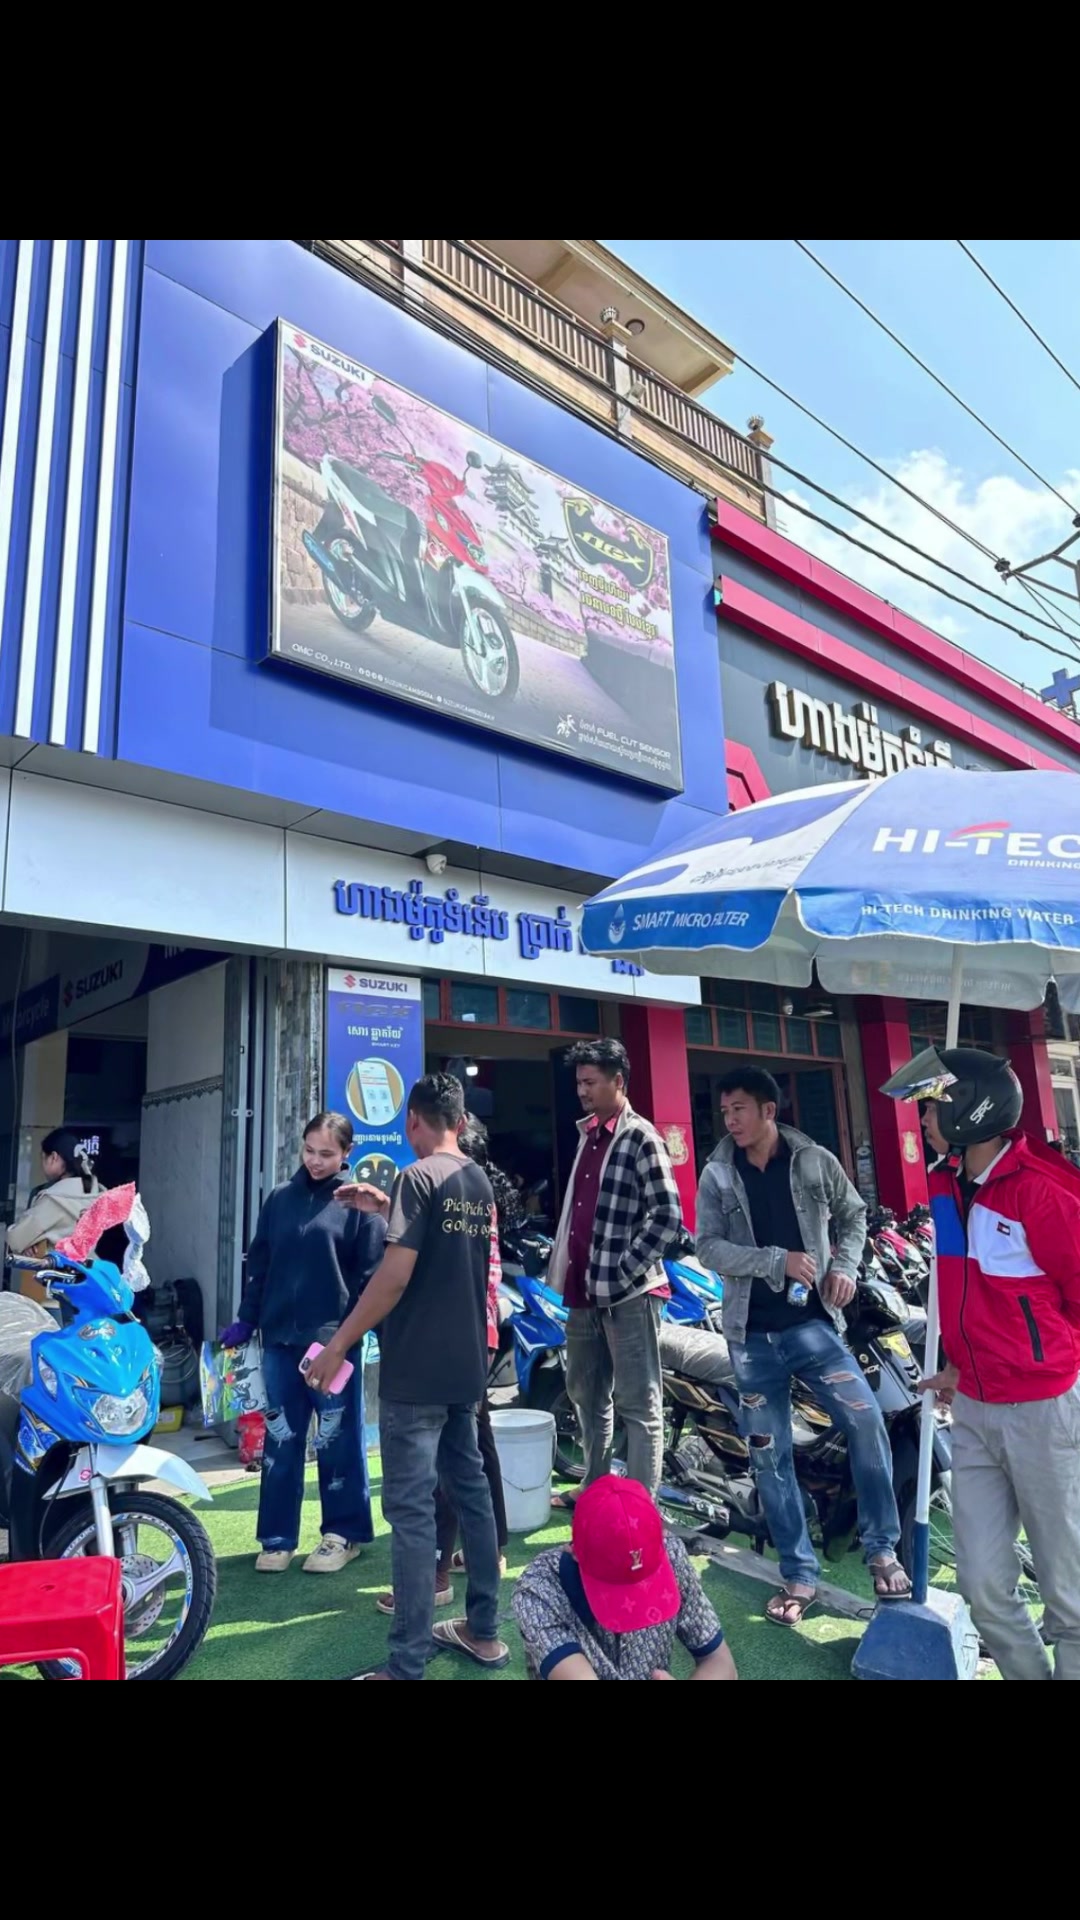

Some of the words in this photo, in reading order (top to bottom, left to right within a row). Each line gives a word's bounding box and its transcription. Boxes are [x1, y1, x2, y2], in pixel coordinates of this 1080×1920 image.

[310, 344, 365, 381] SUZUKI
[597, 727, 619, 742] FUEL
[620, 735, 638, 748] CUT
[639, 742, 671, 759] SENSOR
[632, 910, 675, 931] SMART
[861, 903, 924, 916] HI-TECH
[930, 907, 1012, 920] DRINKING
[1017, 908, 1075, 925] WATER
[76, 959, 123, 999] SUZUKI
[358, 978, 408, 993] SUZUKI
